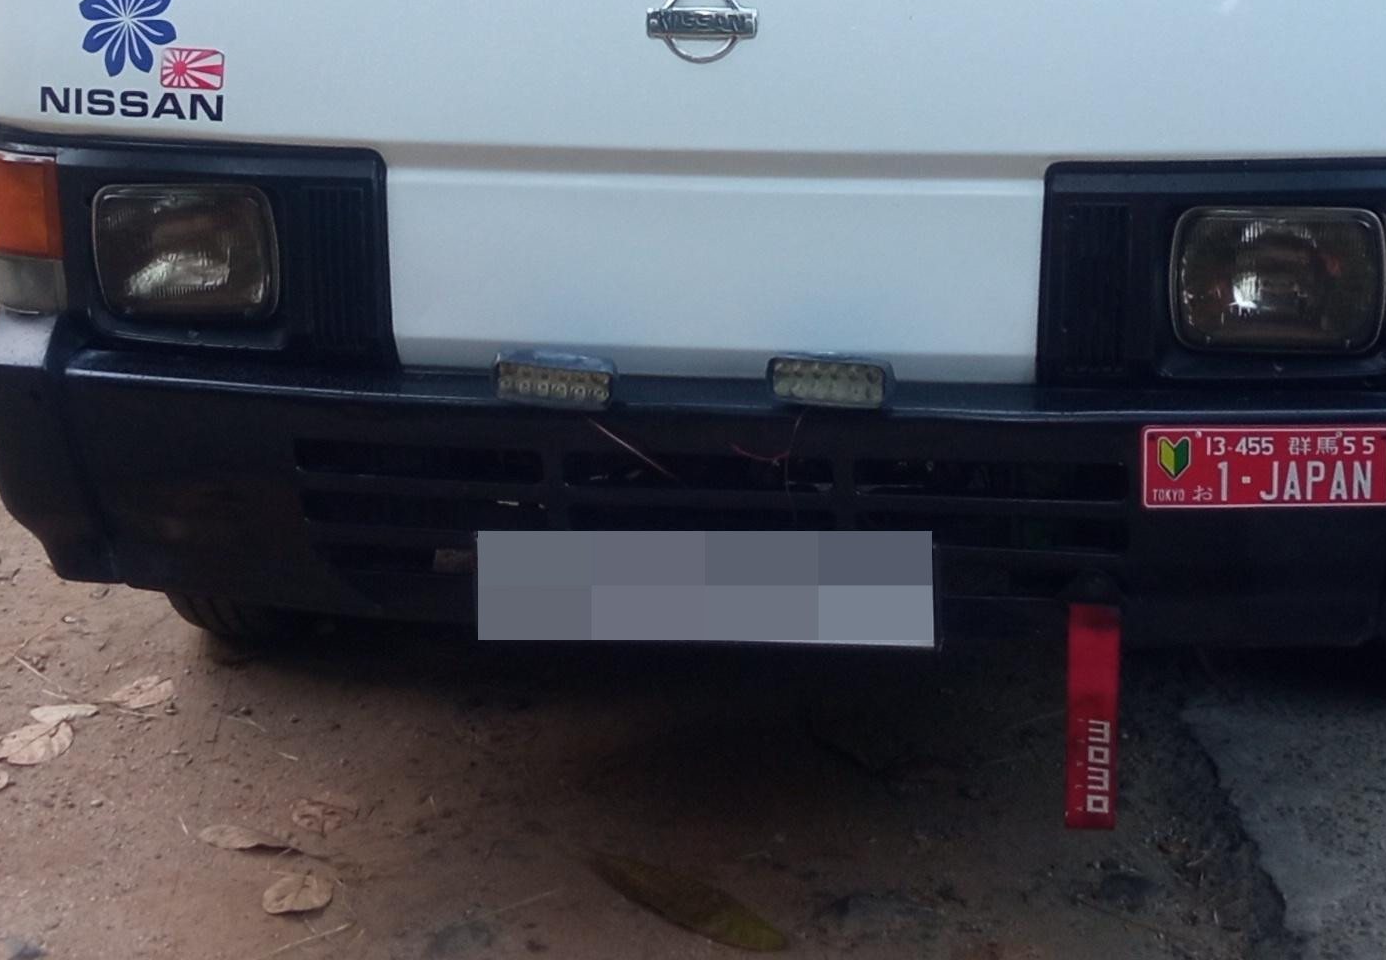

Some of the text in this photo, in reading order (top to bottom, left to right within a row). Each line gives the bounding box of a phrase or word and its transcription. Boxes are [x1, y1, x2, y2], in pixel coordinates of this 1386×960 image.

[39, 86, 224, 122] NISSAN
[1206, 436, 1275, 456] 13-455
[1152, 488, 1185, 501] TOKYO
[1087, 719, 1111, 814] momo
